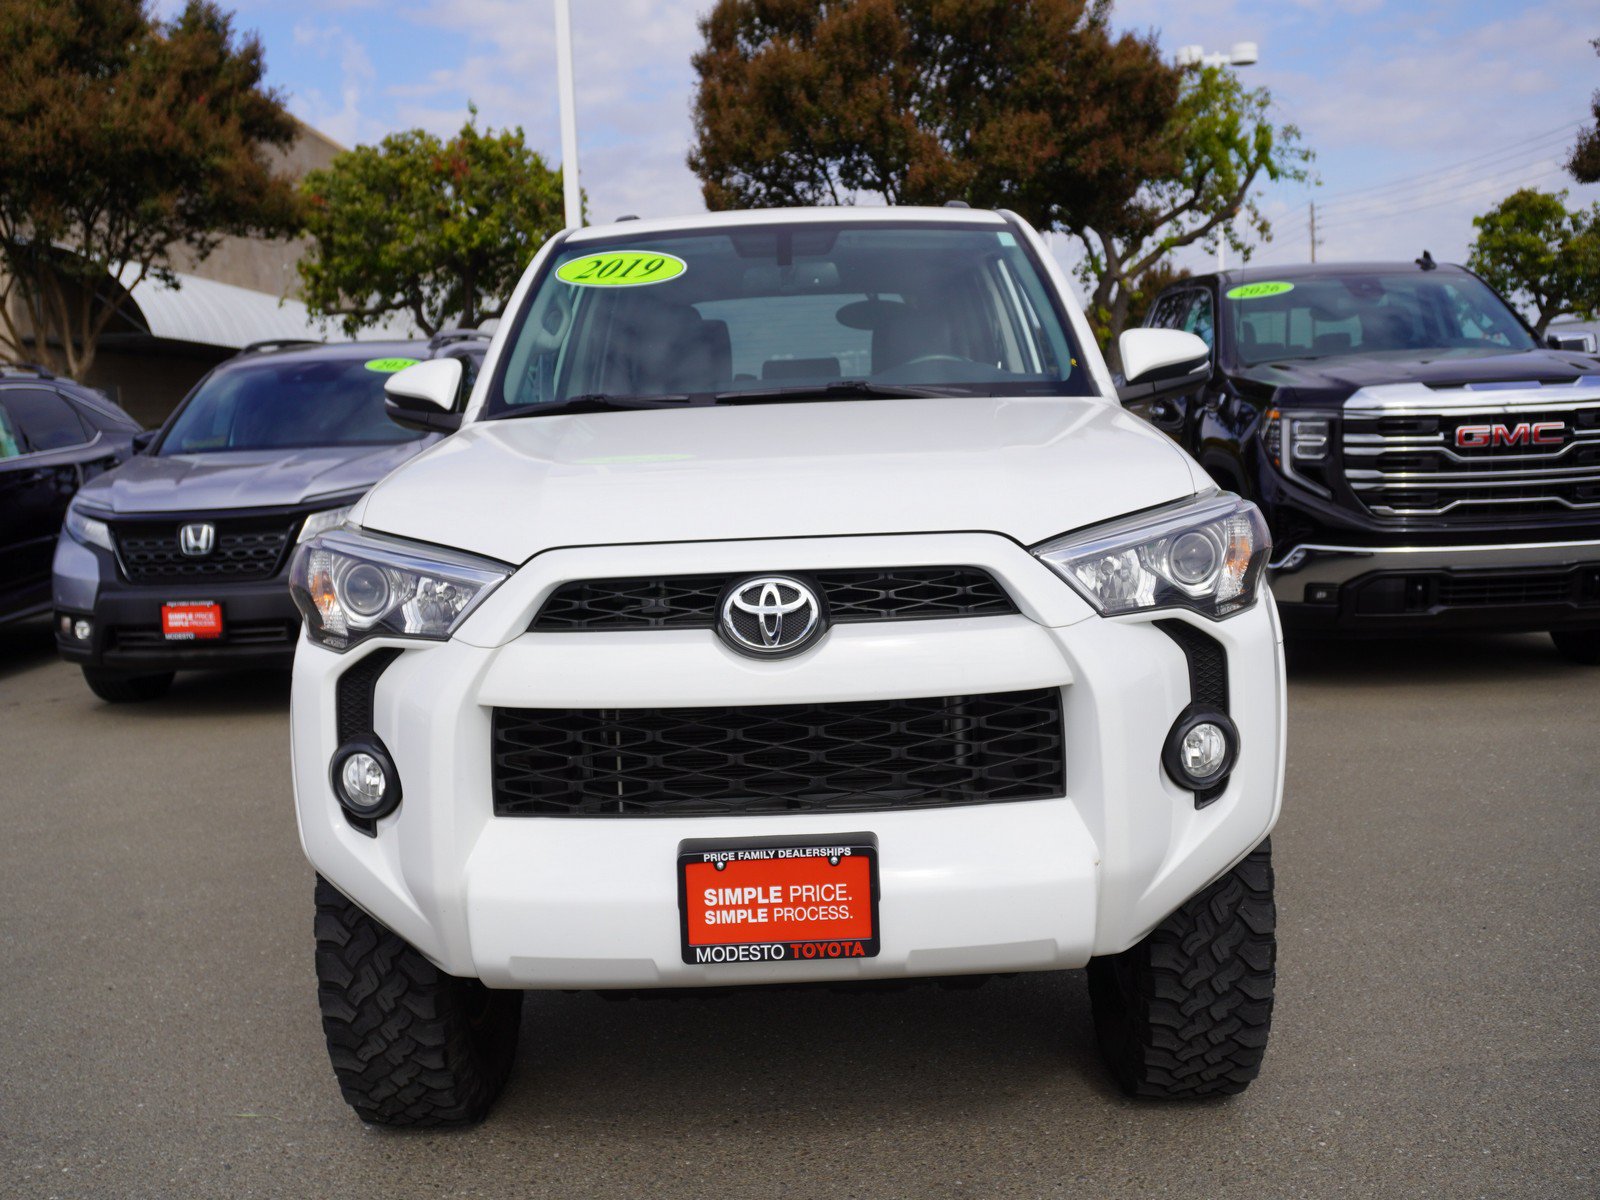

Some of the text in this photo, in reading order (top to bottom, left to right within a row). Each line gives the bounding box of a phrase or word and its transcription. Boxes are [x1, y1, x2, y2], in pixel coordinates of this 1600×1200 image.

[573, 258, 665, 279] 2019
[1455, 421, 1565, 447] GMC
[703, 847, 851, 862] PRICE FAMILY DEALERSHIPS
[704, 883, 852, 906] SIMPLE PRICE.
[704, 905, 853, 925] SIMPLE PROCESS.
[696, 941, 865, 963] MODESTO TOYOTA
